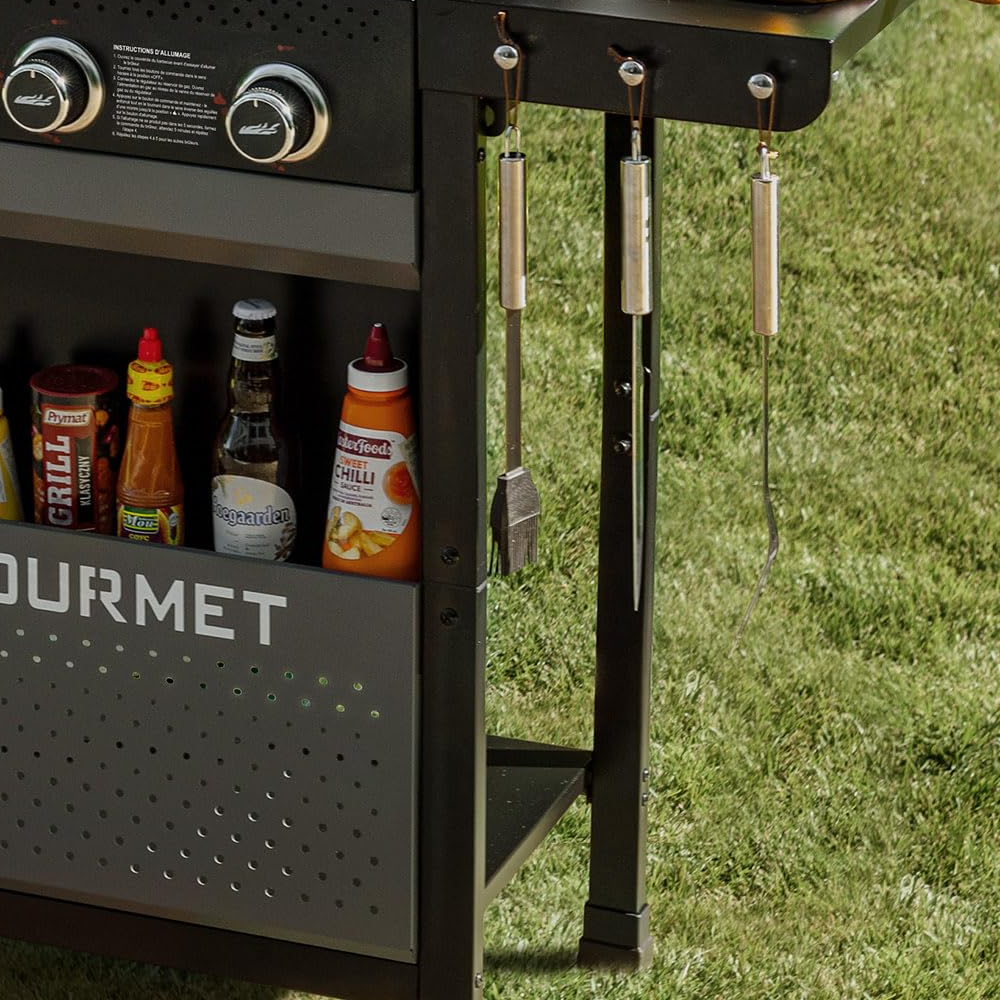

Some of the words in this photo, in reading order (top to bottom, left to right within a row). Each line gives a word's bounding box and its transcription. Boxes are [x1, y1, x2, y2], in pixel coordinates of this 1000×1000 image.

[113, 44, 154, 55] INSTRUCTIONS
[47, 411, 88, 425] Prymat
[339, 455, 369, 470] SWEET
[45, 434, 73, 526] GRILL
[77, 455, 92, 506] KLASYCZNY
[334, 464, 376, 486] CHILLI
[340, 482, 361, 493] SAUCE
